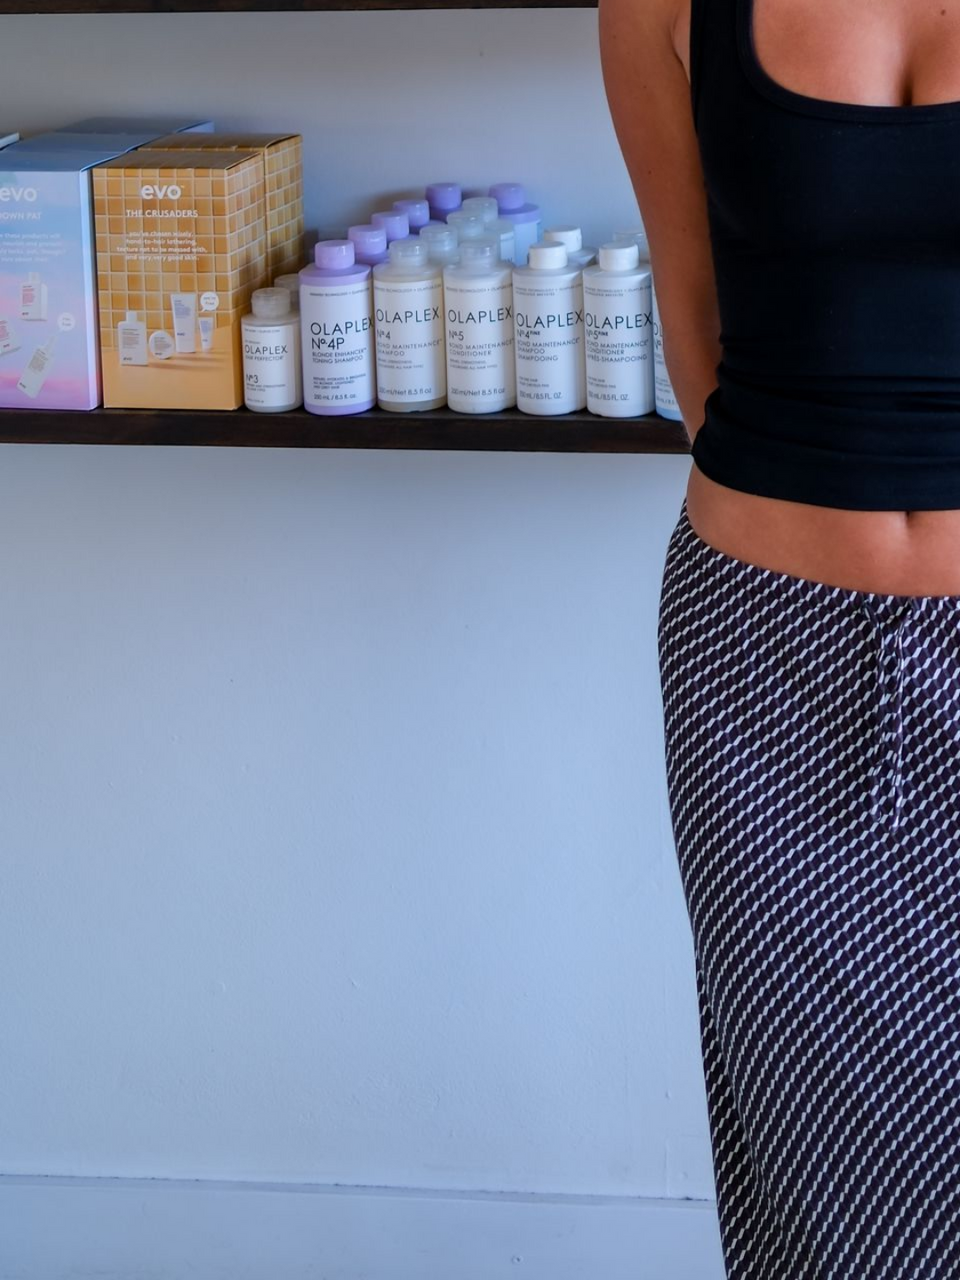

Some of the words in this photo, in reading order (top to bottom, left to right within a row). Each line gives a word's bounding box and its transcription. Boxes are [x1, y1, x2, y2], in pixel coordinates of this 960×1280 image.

[141, 184, 182, 199] evo
[126, 210, 142, 218] THE
[144, 210, 198, 218] CRUSADERS
[376, 306, 440, 324] OLAPLEX
[448, 306, 512, 324] OLAPLEX
[516, 310, 583, 329] OLAPLEX
[586, 312, 653, 329] OLAPLEX
[310, 316, 374, 336] OLAPLEX
[245, 345, 288, 355] OLAPLEX
[335, 355, 363, 363] SHAMPOO
